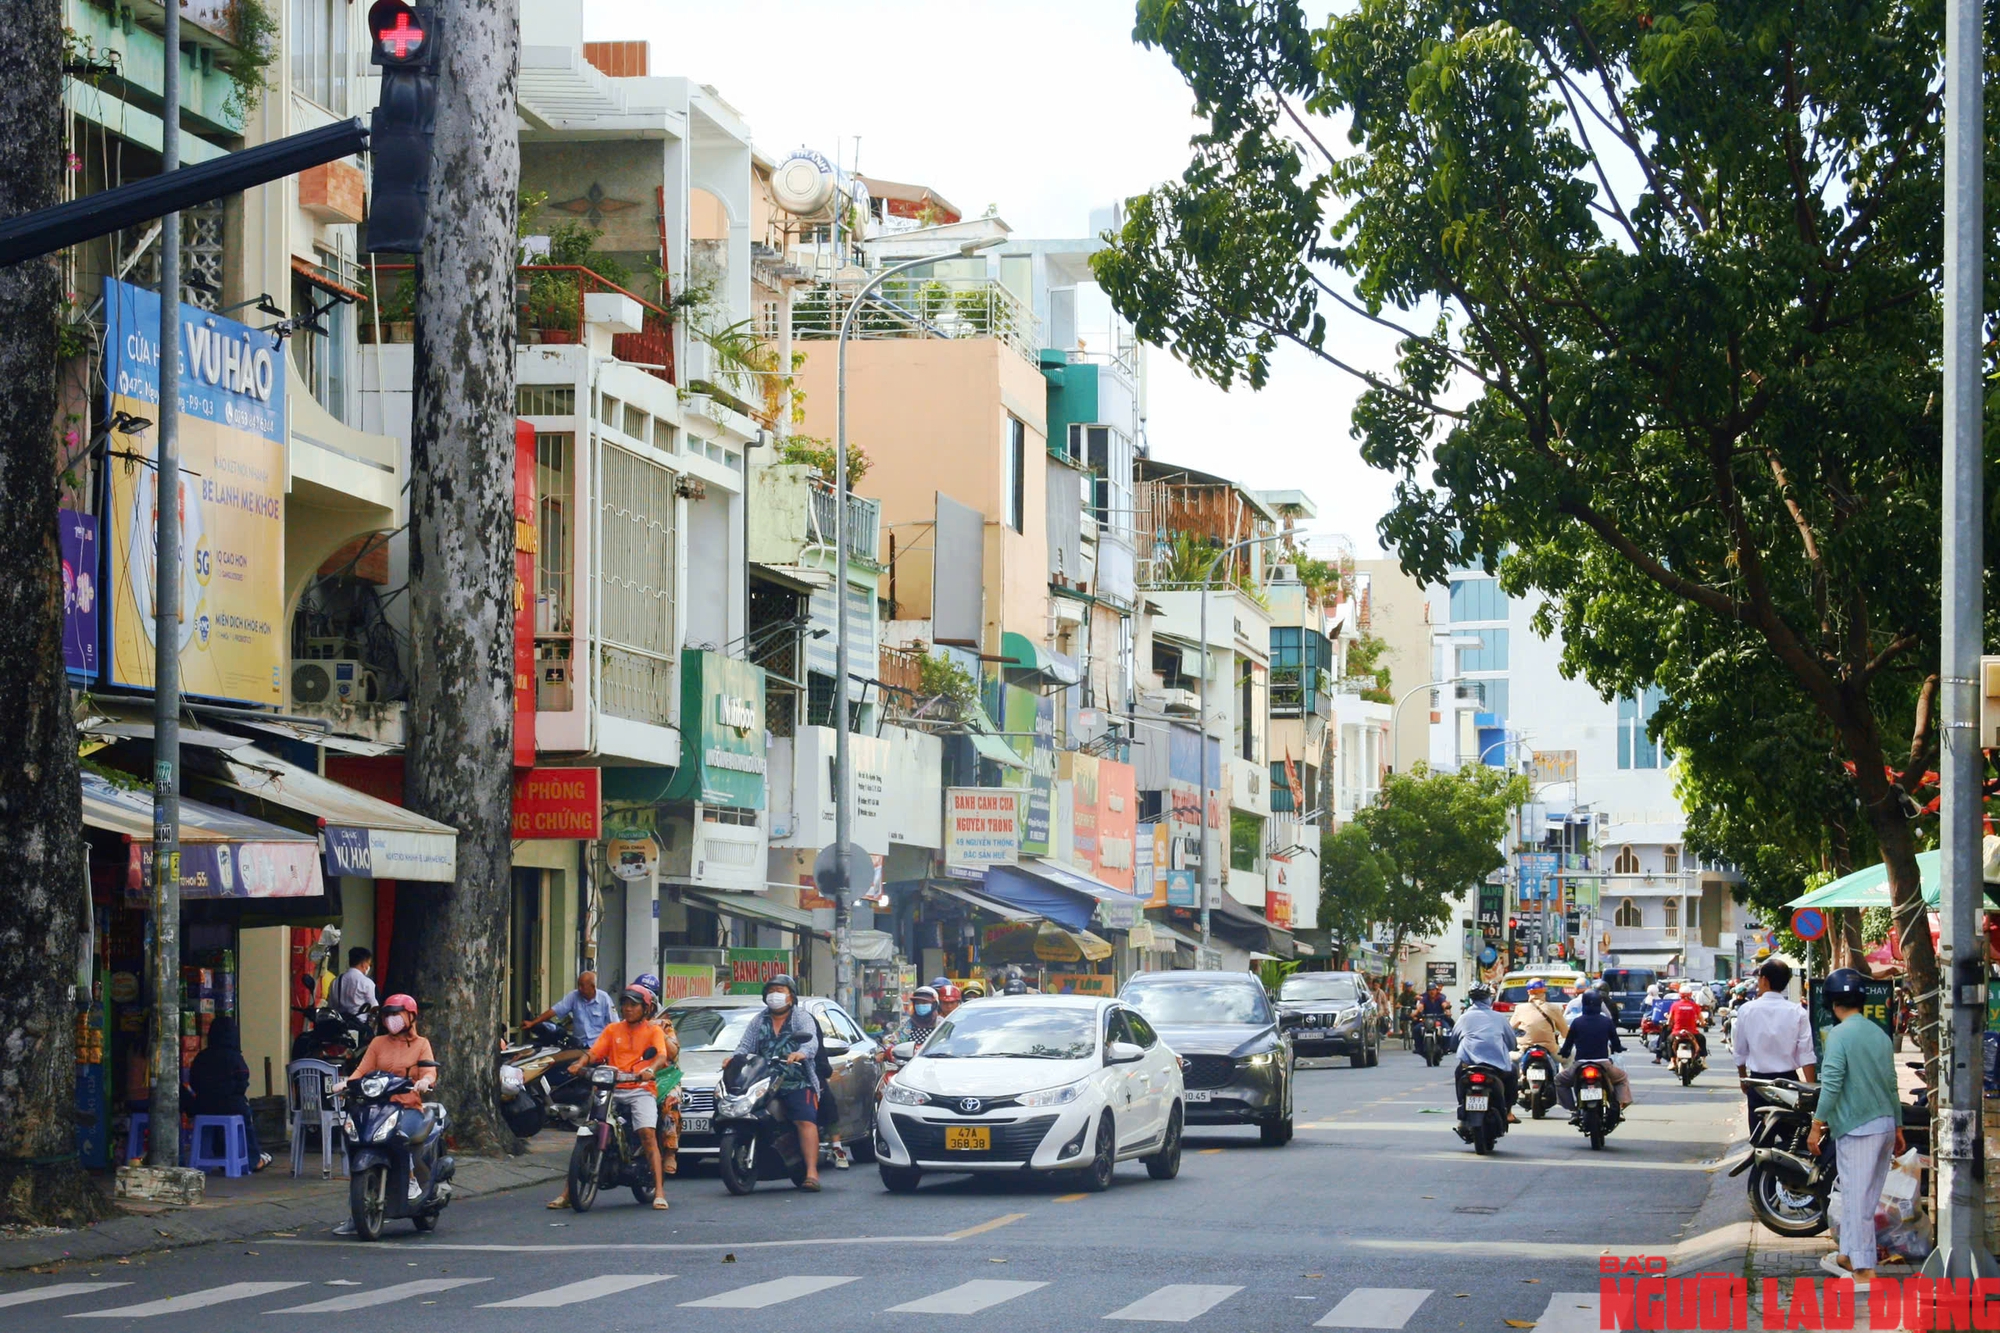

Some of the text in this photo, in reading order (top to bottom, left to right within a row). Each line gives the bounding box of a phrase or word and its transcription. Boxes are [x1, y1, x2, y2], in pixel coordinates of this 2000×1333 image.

[202, 476, 213, 502] BÉ
[196, 550, 210, 575] 5G
[223, 551, 235, 565] CAO
[528, 777, 585, 799] PHÒNG
[999, 796, 1014, 811] CUA
[535, 808, 593, 830] CHỨNG
[1482, 911, 1499, 923] HÀ
[733, 953, 759, 982] BÁNH
[666, 970, 688, 999] BÁNH
[1863, 1005, 1886, 1019] FE
[958, 1128, 977, 1138] 47A
[951, 1139, 985, 1148] 368.38
